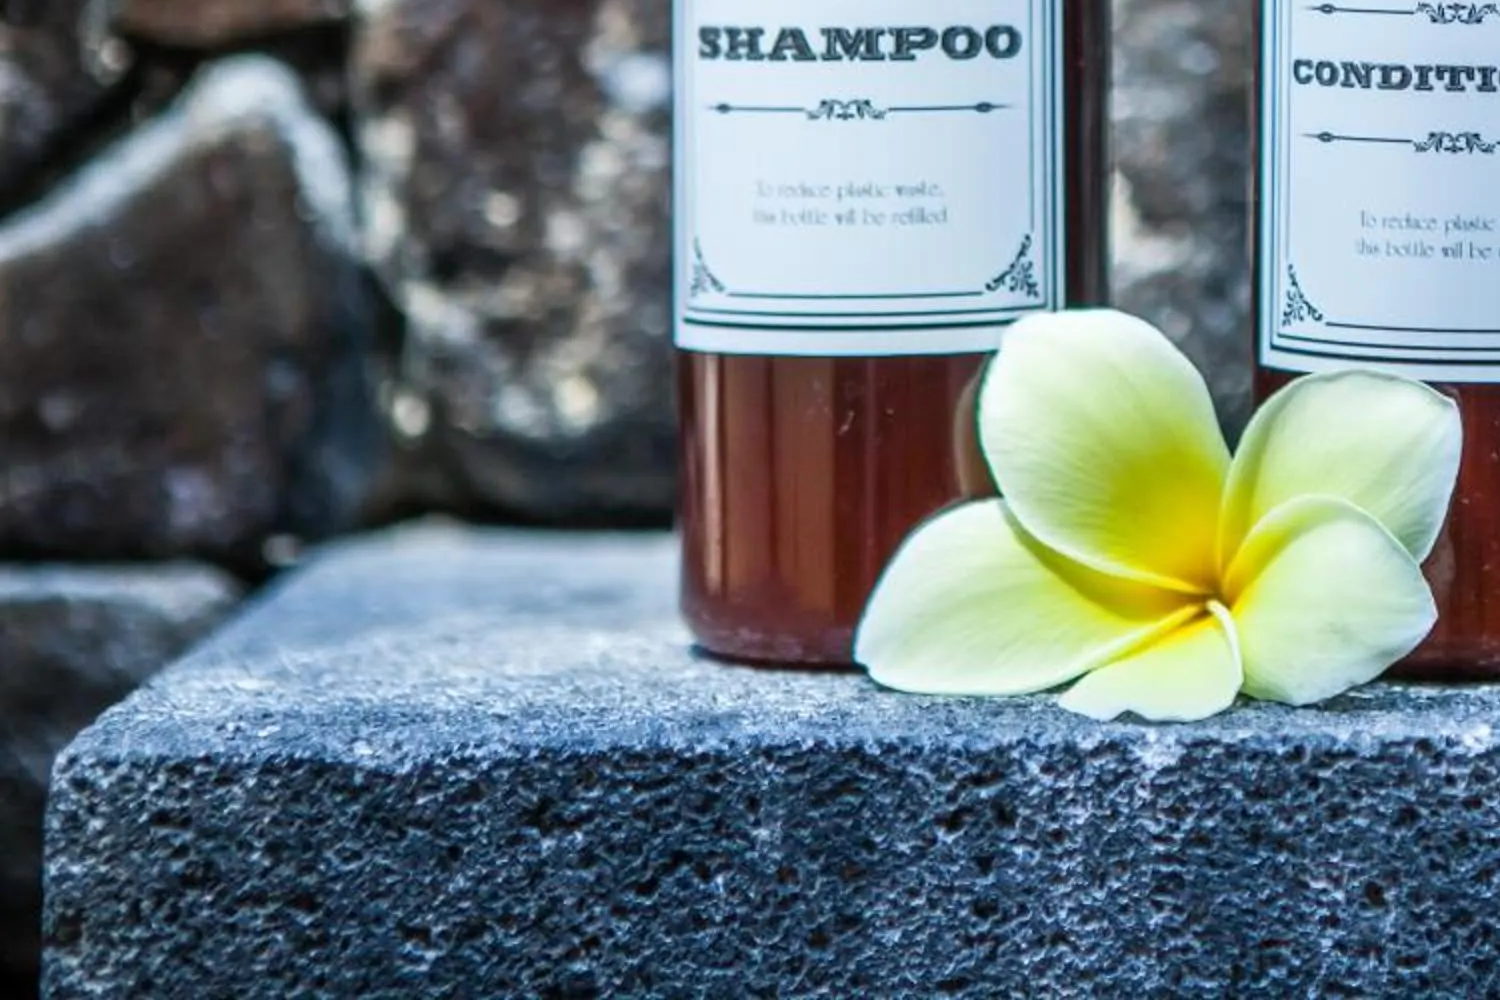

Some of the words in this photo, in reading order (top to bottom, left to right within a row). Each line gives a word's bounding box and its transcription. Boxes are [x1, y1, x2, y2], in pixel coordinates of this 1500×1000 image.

[699, 24, 1022, 61] SHAMPOO
[1444, 214, 1494, 237] plastic
[1385, 240, 1434, 258] bottle
[1441, 242, 1463, 258] will
[1469, 242, 1492, 259] be
